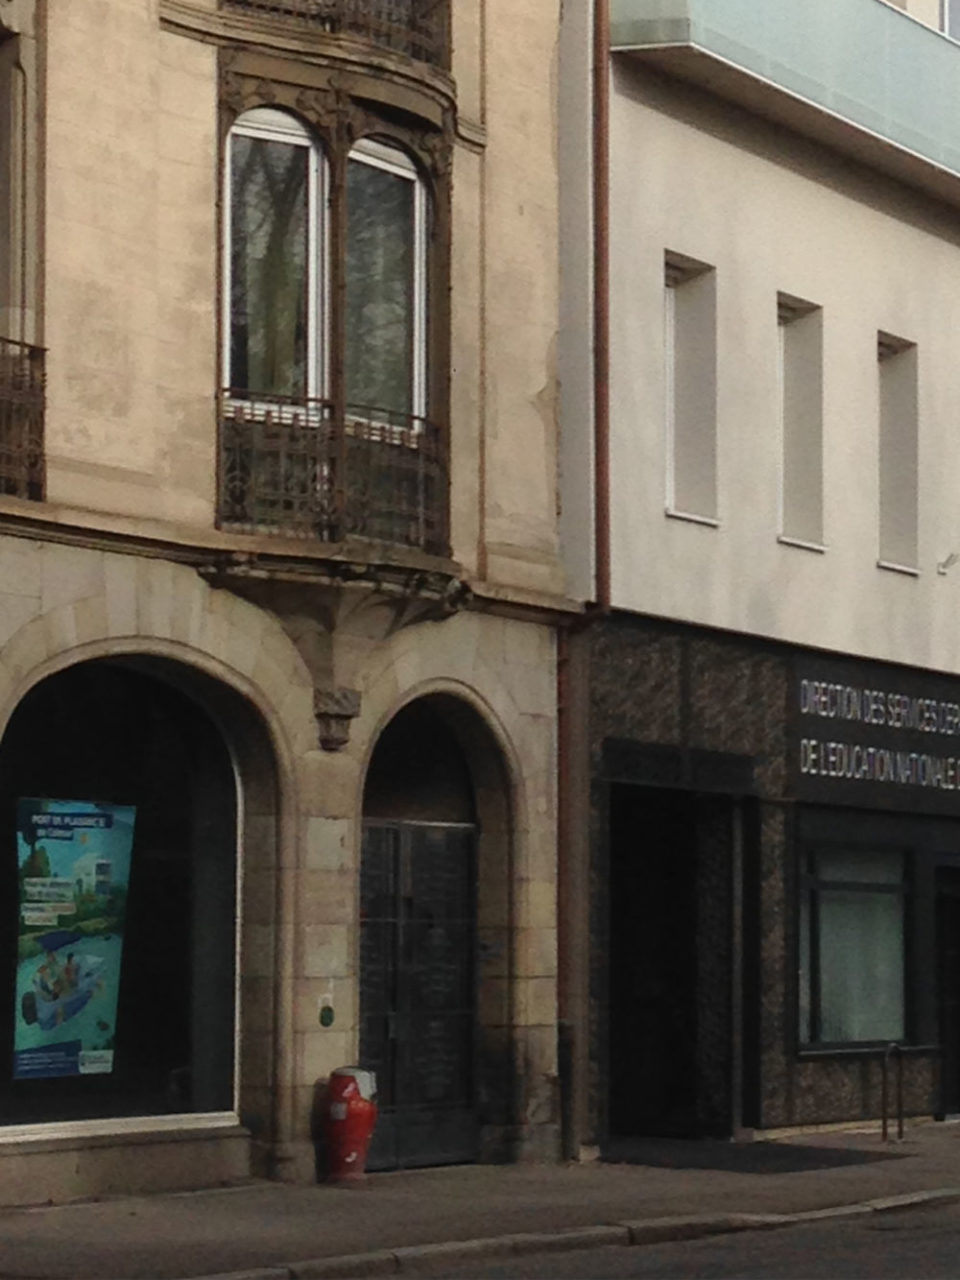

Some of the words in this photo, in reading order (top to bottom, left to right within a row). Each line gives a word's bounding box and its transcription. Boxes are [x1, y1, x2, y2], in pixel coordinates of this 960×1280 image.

[800, 678, 862, 721] DIRECTION
[864, 689, 886, 725] DES
[888, 693, 937, 732] SERVICES
[800, 738, 818, 774] DE
[896, 751, 955, 791] NATIONALE
